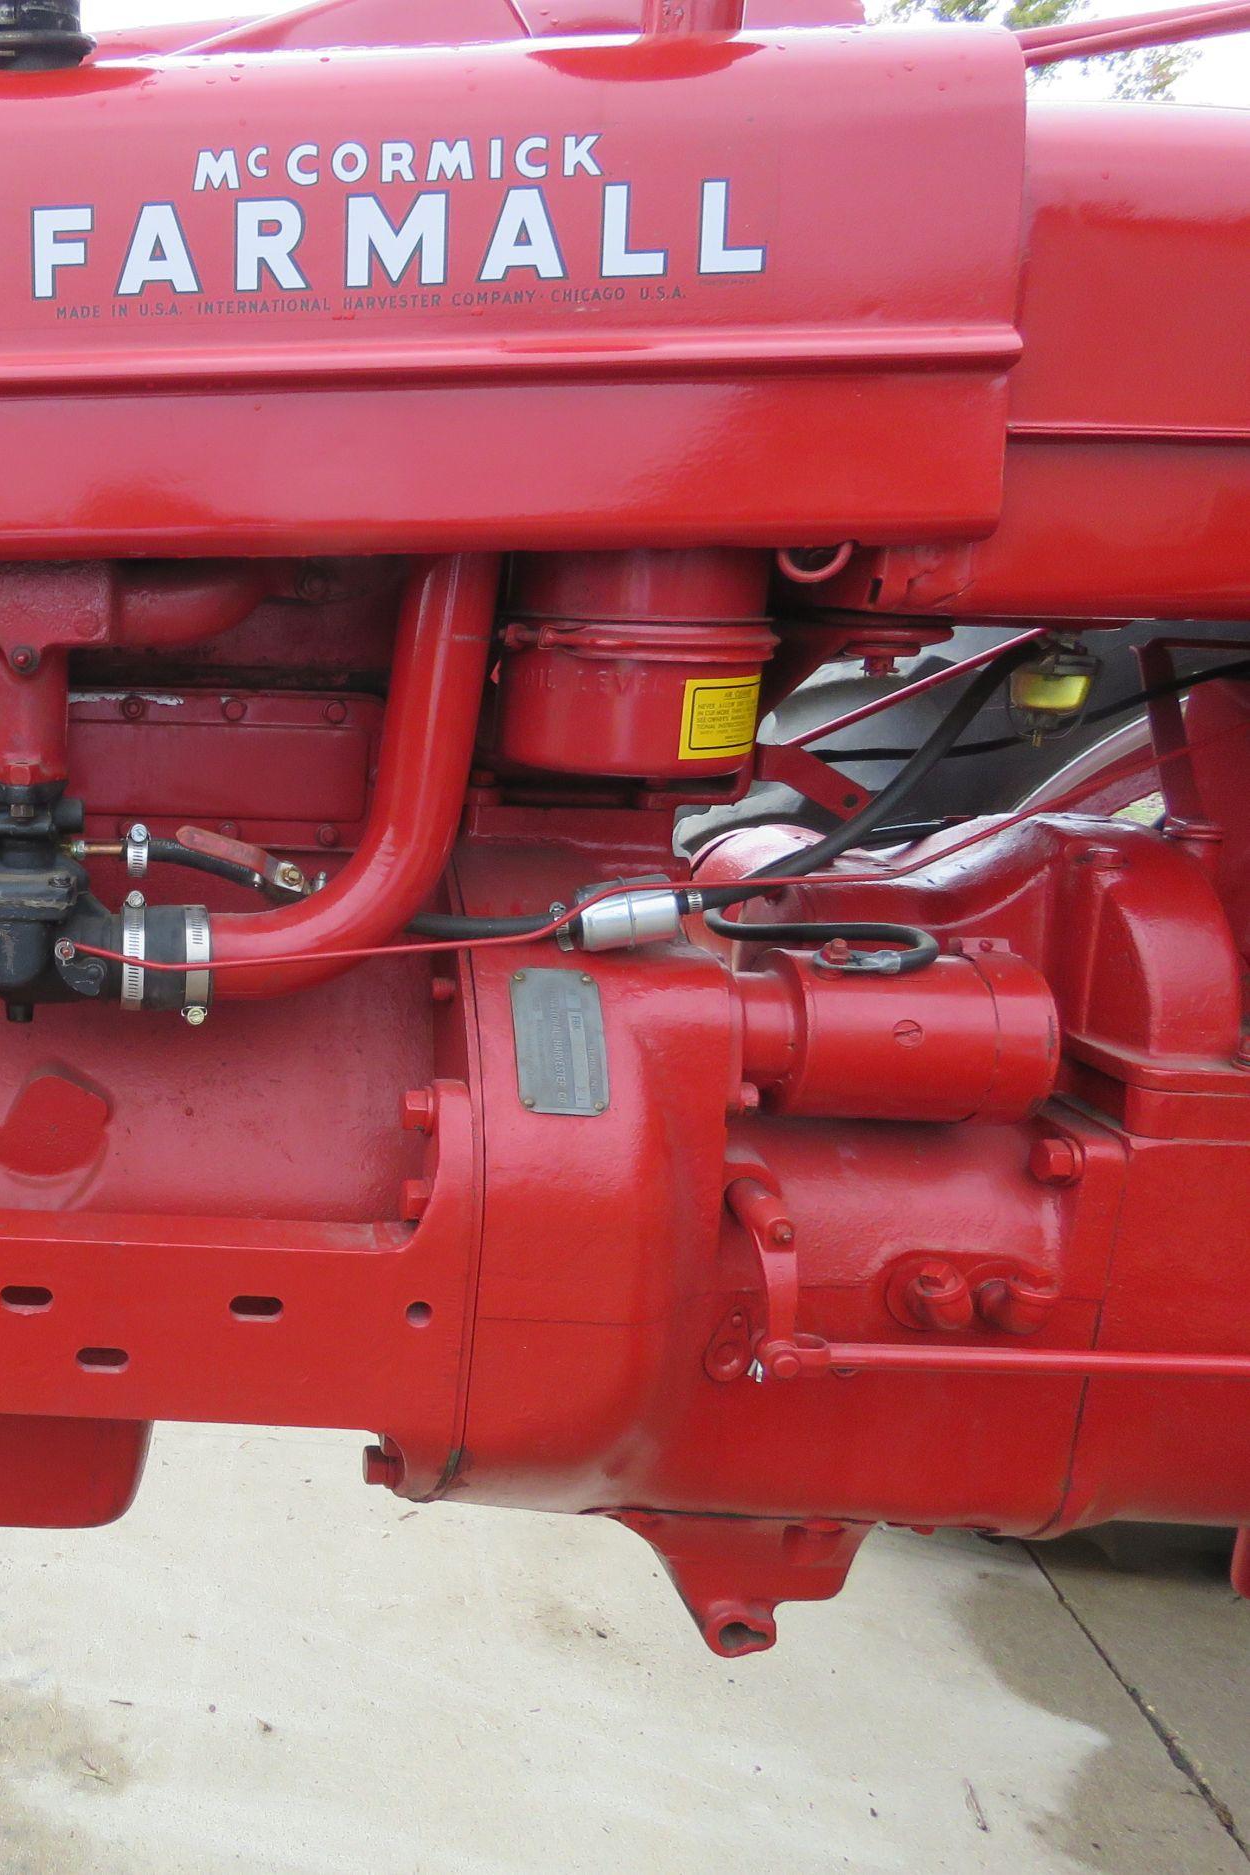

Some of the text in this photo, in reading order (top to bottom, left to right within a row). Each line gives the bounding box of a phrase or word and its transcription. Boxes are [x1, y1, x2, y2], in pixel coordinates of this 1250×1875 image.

[31, 178, 767, 300] FARMALL
[56, 285, 686, 320] MADE IN U.S.A. INTERNATIONAL HARVESTER COMPANY CHICAGO U.S.A.
[553, 1039, 567, 1087] HARVESTER
